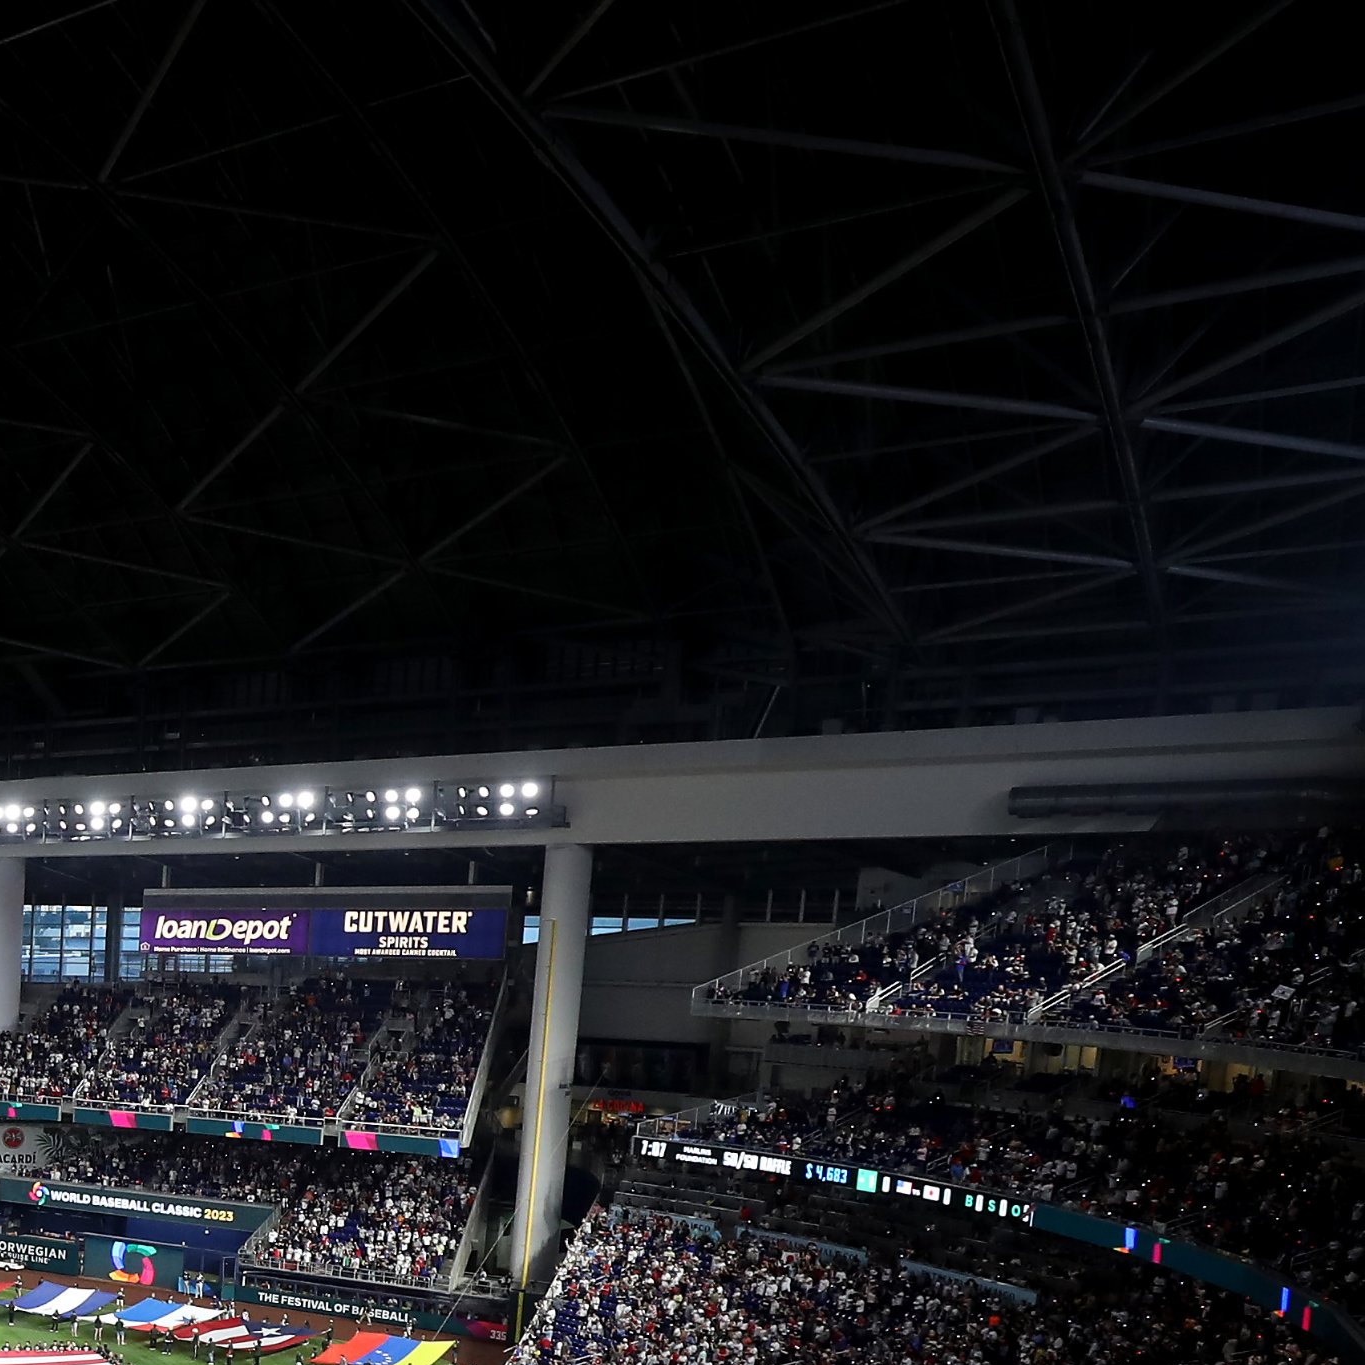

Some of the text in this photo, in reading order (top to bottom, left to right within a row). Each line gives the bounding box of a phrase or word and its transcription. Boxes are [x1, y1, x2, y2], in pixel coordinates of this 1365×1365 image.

[344, 911, 468, 933] CUTWATER
[154, 915, 292, 945] loanDepot
[378, 936, 429, 948] SPIRITS
[675, 1153, 718, 1166] FOUNDATION
[816, 1164, 848, 1184] 4,683
[50, 1190, 235, 1222] WORLD BASEBALL CLASSIC 2023
[964, 1194, 974, 1208] B
[987, 1199, 996, 1213] S
[30, 1256, 50, 1265] LINE
[257, 1291, 279, 1303] THE
[280, 1294, 332, 1313] FESTIVAL
[333, 1303, 349, 1314] OF
[490, 1329, 507, 1341] 335
